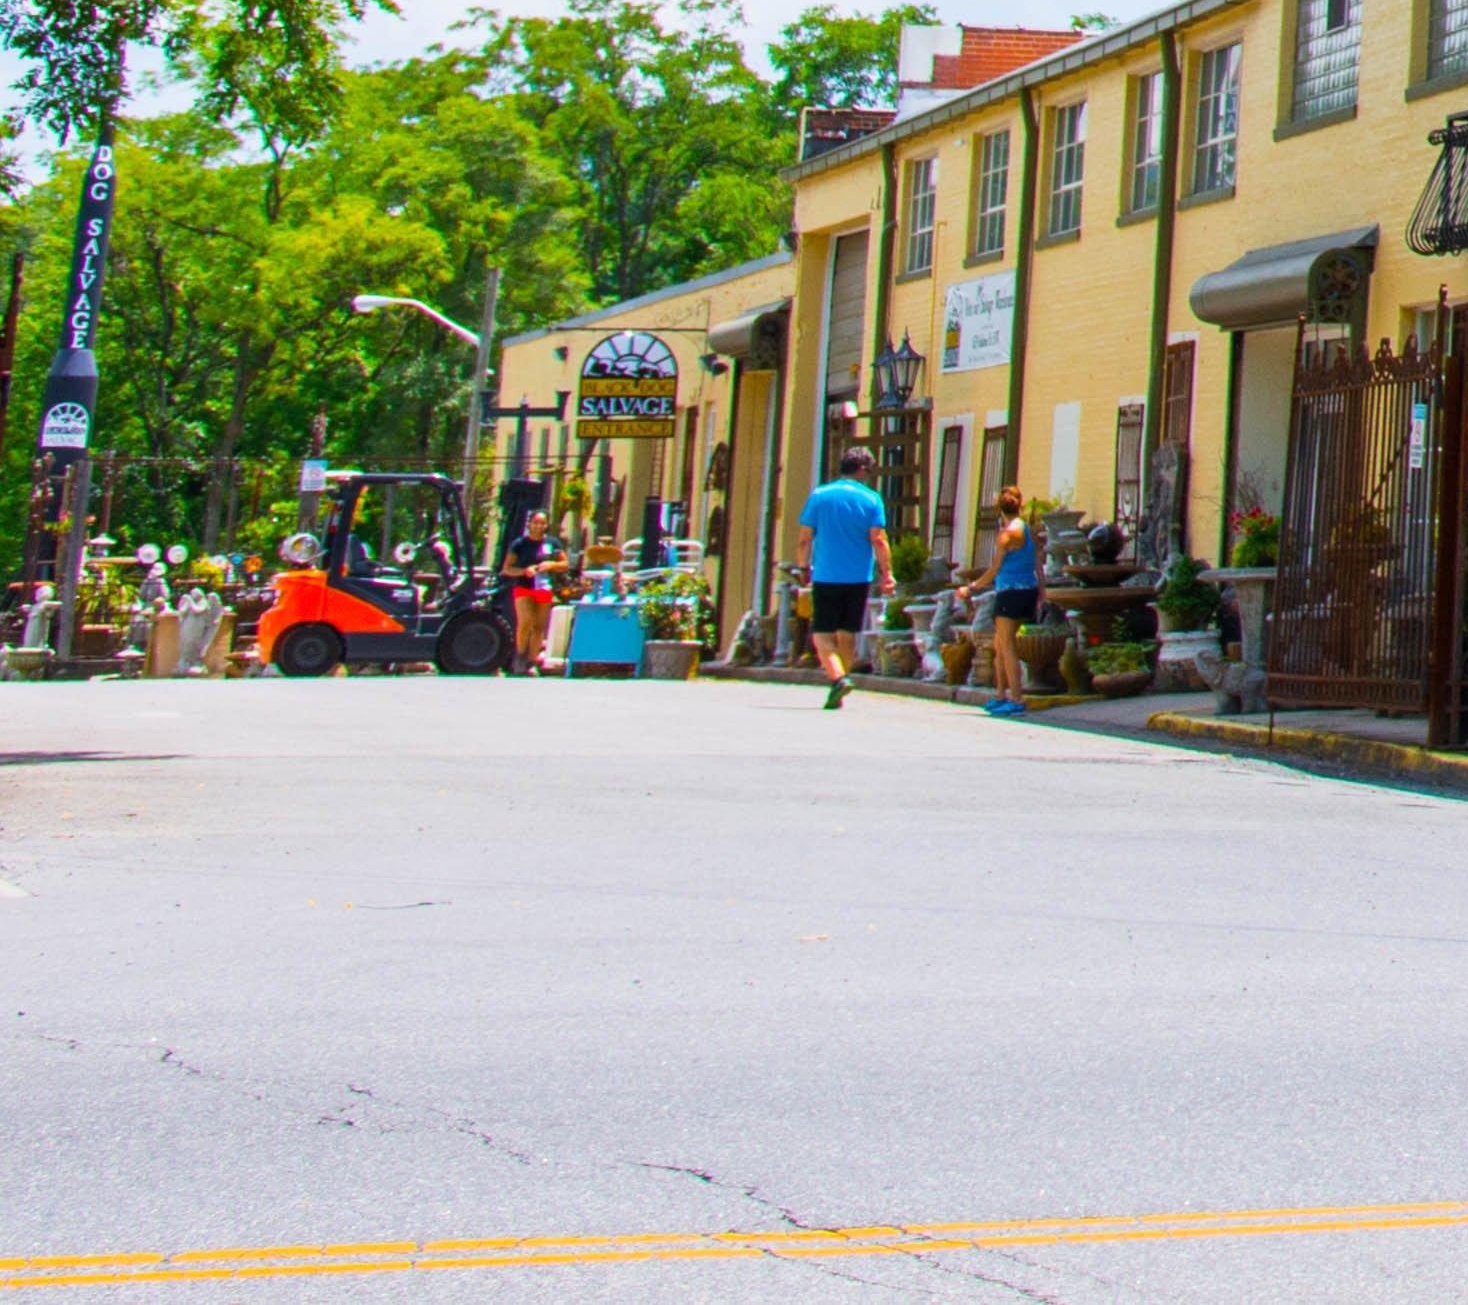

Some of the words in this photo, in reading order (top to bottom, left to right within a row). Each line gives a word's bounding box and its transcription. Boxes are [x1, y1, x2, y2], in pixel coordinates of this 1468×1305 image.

[90, 145, 113, 201] DOG
[71, 219, 103, 350] SALVAGE
[581, 396, 673, 415] SALVAGE
[583, 422, 671, 436] ENTRANCE
